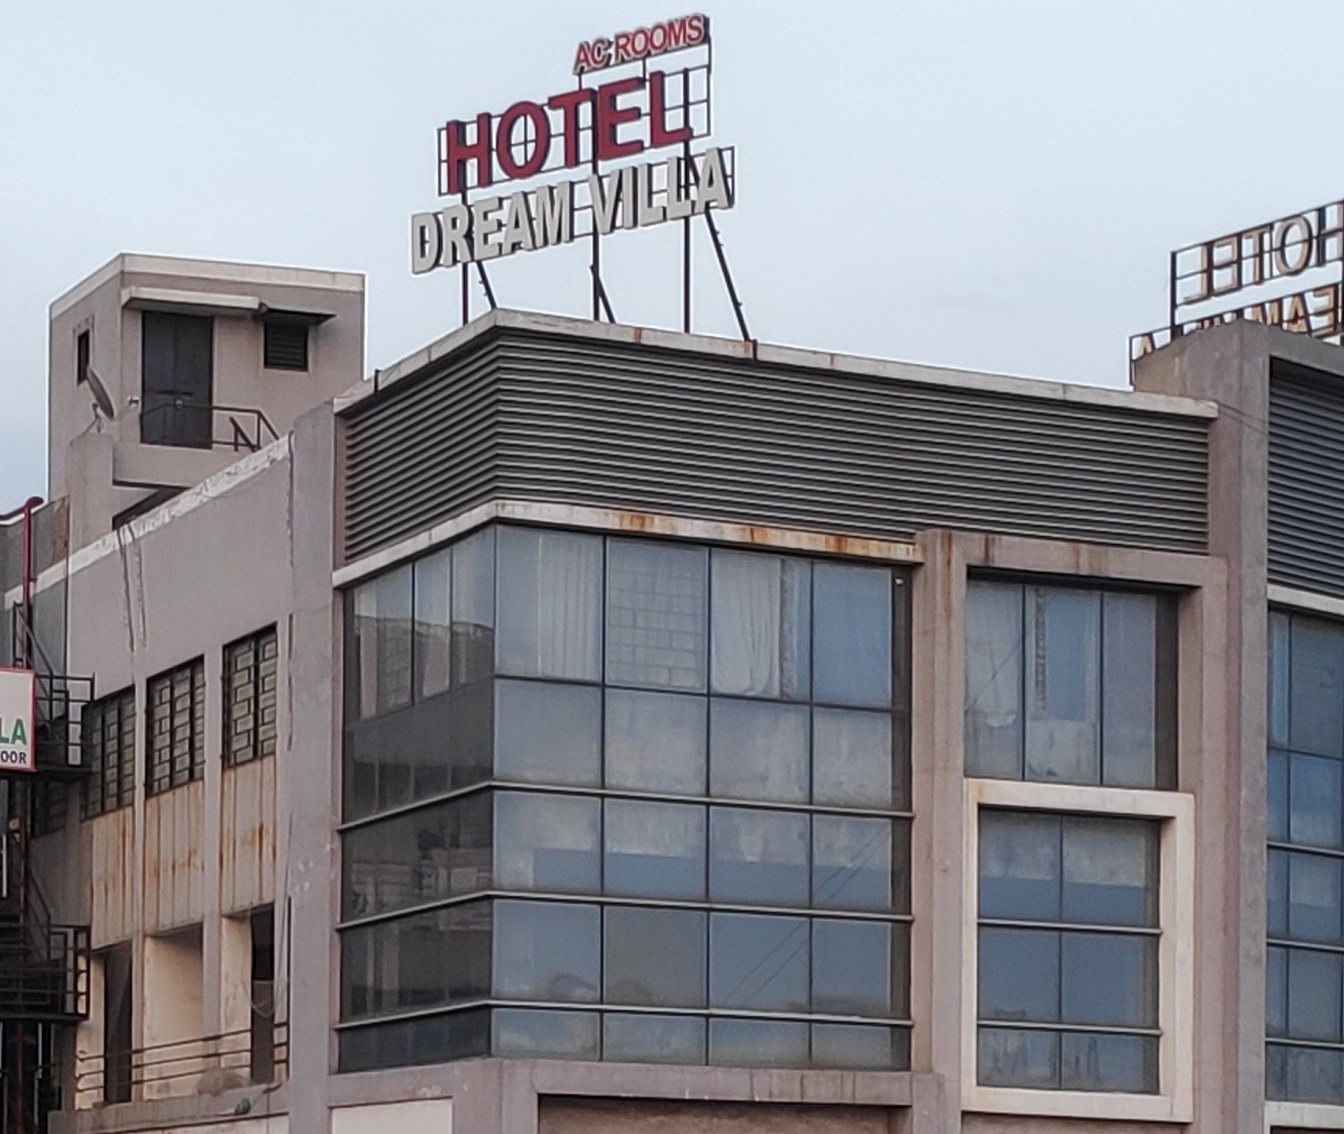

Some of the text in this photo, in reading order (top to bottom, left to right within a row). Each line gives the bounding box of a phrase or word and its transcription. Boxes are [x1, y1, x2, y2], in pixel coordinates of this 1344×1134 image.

[573, 14, 708, 75] AC ROOMS
[446, 71, 692, 195] HOTEL
[411, 147, 734, 275] DREAM VILLA
